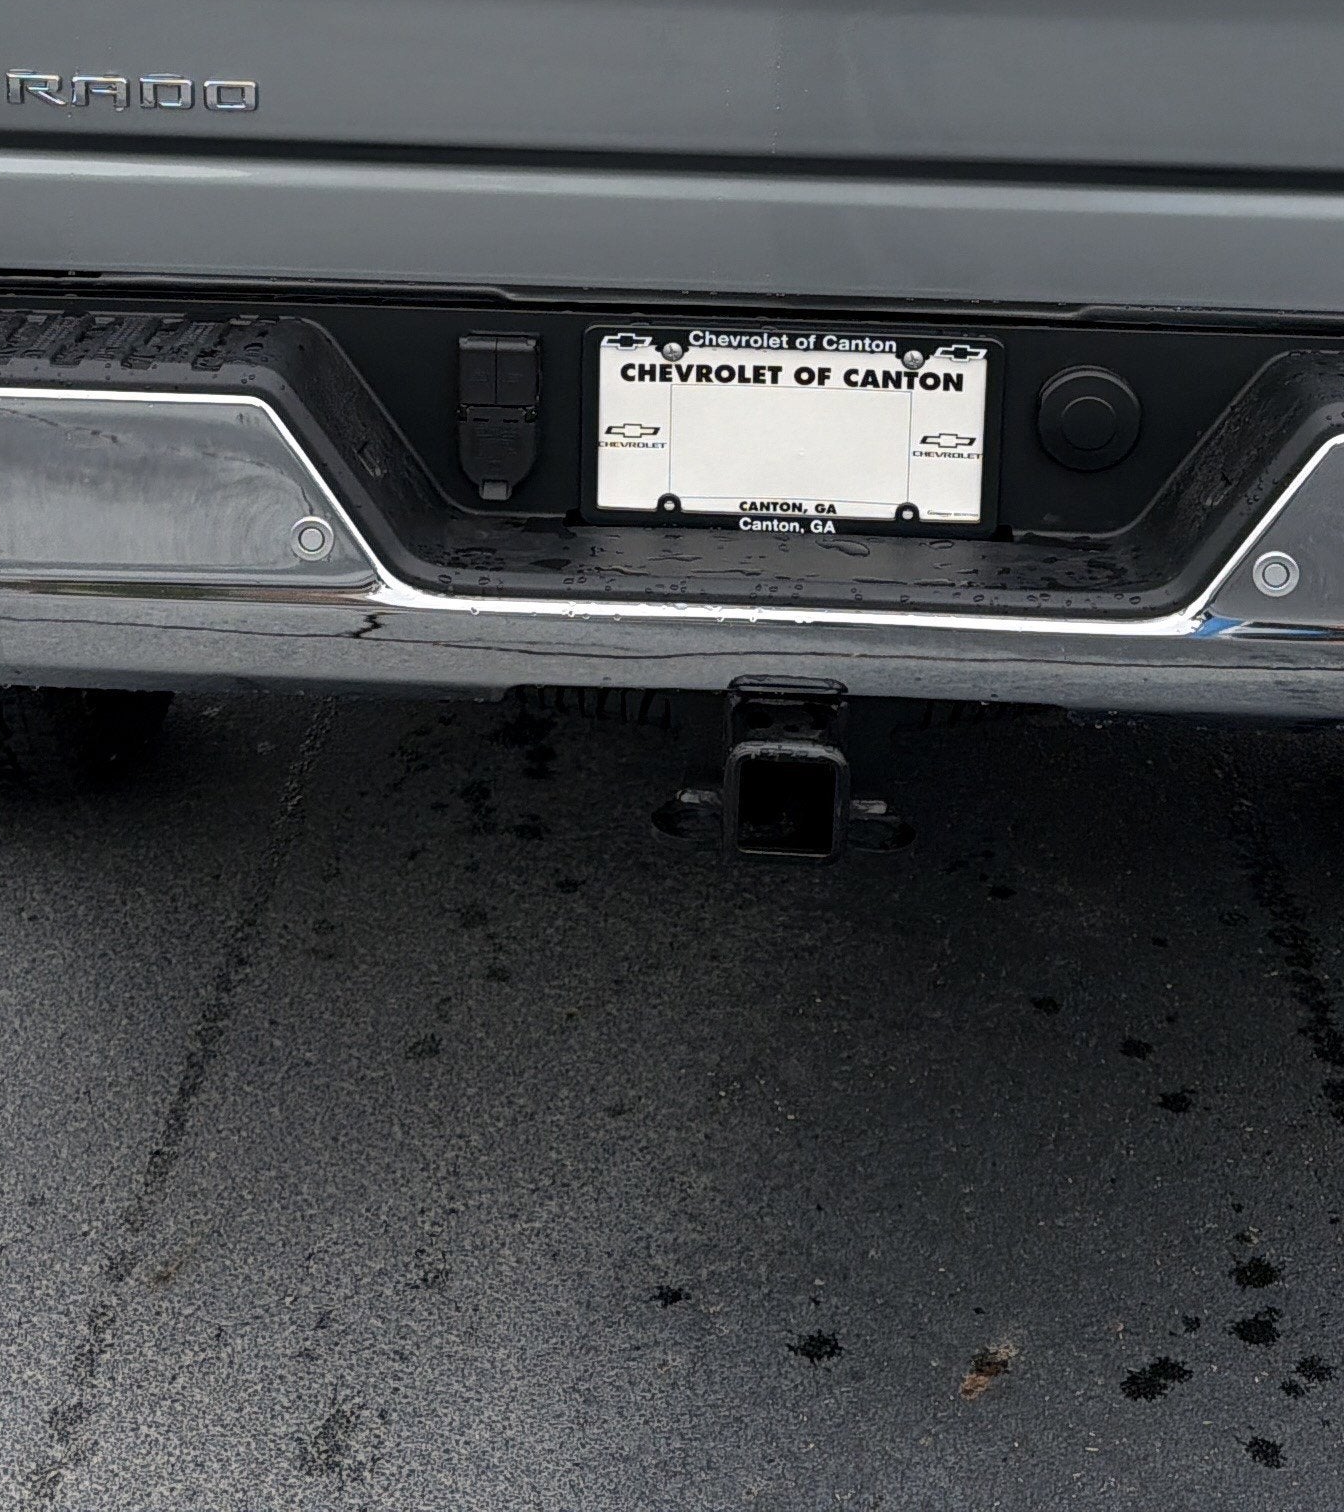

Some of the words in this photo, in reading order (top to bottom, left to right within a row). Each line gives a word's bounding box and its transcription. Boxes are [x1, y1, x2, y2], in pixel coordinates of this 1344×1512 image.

[688, 331, 788, 349] Chevrolet
[795, 334, 817, 351] of
[822, 335, 897, 352] Canton
[620, 363, 783, 384] CHEVROLET
[794, 366, 831, 386] OF
[843, 368, 964, 392] CANTON
[739, 501, 808, 514] CANTON,
[815, 503, 837, 514] GA
[739, 517, 805, 534] Canton,
[810, 519, 836, 534] GA
